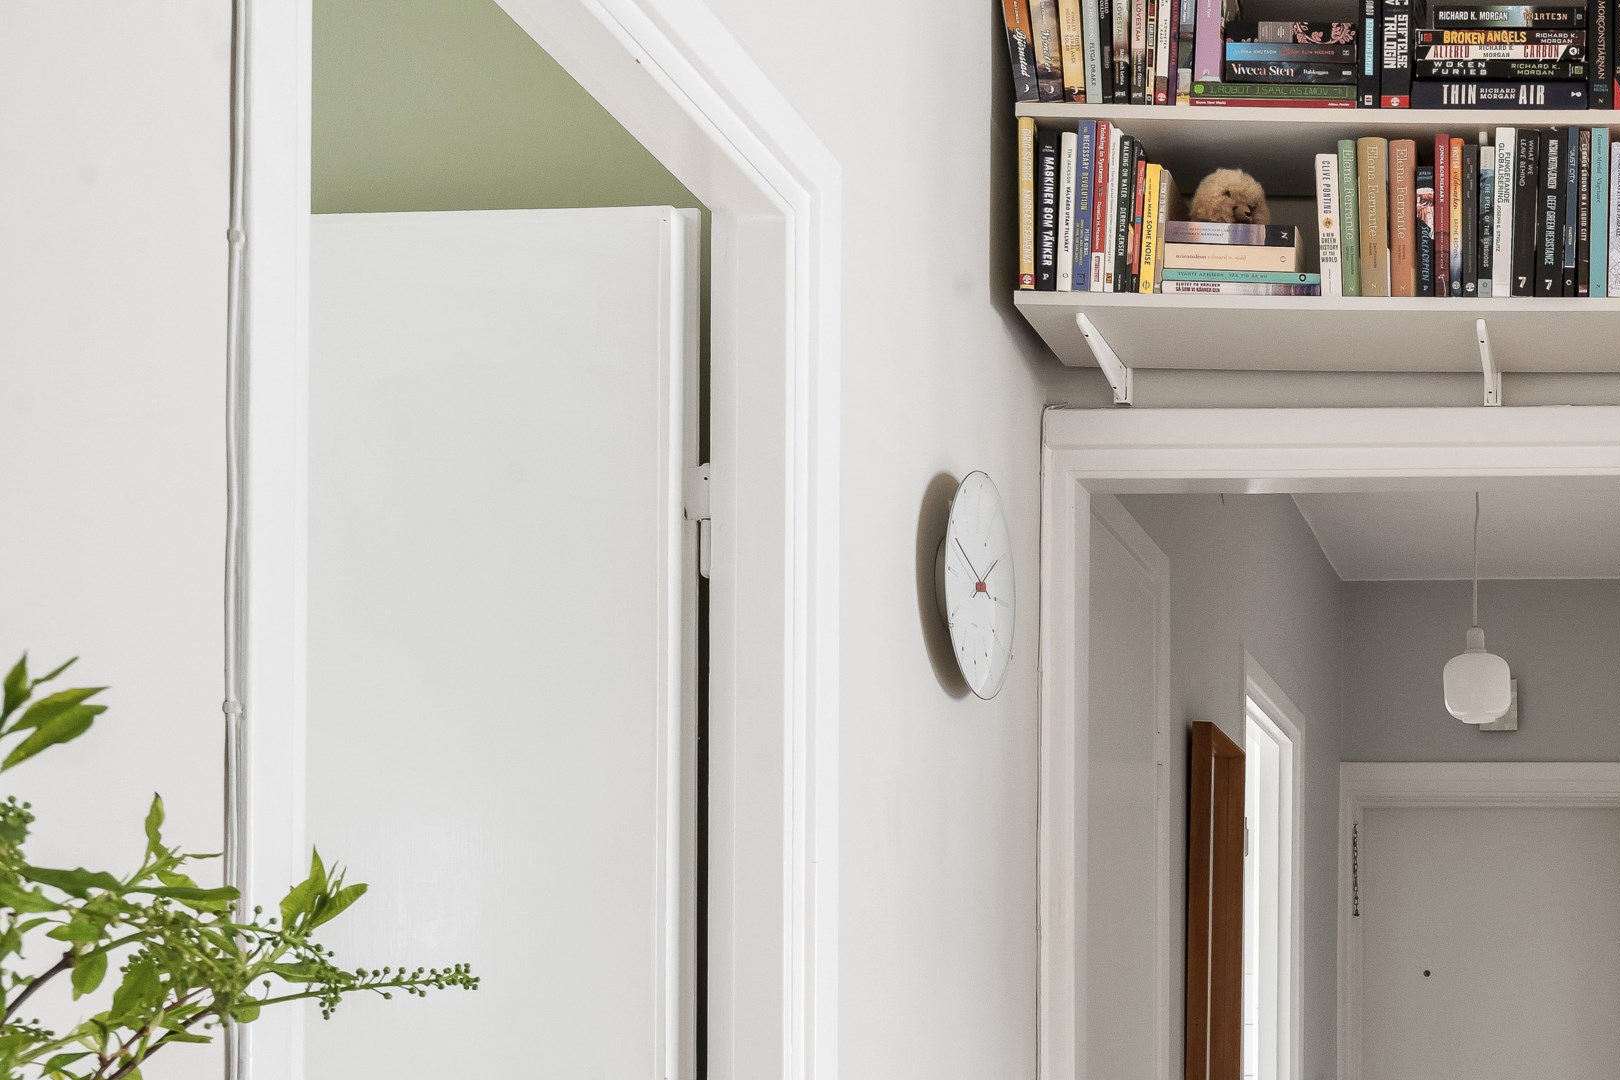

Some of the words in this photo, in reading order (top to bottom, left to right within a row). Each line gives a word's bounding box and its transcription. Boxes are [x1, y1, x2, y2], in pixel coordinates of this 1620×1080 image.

[1438, 11, 1469, 20] RICHARD
[1470, 11, 1477, 20] K.
[1479, 11, 1508, 20] MORGAN
[1384, 16, 1397, 69] TRILOGIN
[1397, 14, 1408, 69] STIFTELSE
[1443, 30, 1485, 44] BROKEN
[1487, 31, 1527, 43] ANGELS
[1013, 27, 1030, 78] Björnstad
[1433, 45, 1470, 58] ALTERED
[1523, 45, 1559, 58] CARBON
[1231, 63, 1266, 76] Viveca
[1268, 65, 1294, 77] Sten
[1256, 86, 1288, 94] ISAAC
[1290, 86, 1329, 95] ASIMOV
[1442, 84, 1477, 104] THIN
[1518, 84, 1545, 104] AIR
[1098, 123, 1108, 150] Thinking
[1082, 134, 1091, 170] NECESSARY
[1123, 140, 1131, 167] WALKING
[1366, 145, 1379, 181] Elena
[1396, 147, 1409, 183] Elena
[1097, 158, 1105, 184] Systems
[1122, 168, 1129, 177] ON
[1321, 160, 1331, 181] CLIVE
[1342, 148, 1354, 184] Elena
[1497, 142, 1505, 204] GLOBALISERING
[1503, 152, 1511, 204] FUNGERANDE
[1527, 163, 1534, 175] WE
[1568, 168, 1576, 184] CITY
[1043, 156, 1055, 205] MASKINER
[1080, 172, 1089, 211] REVOLUTION
[1121, 178, 1129, 199] WATER
[1322, 183, 1332, 214] PONTING
[1367, 183, 1379, 238] Ferrante
[1547, 195, 1557, 210] DEEP
[1043, 206, 1055, 229] SOM
[1119, 207, 1127, 233] DERRICK
[1343, 187, 1355, 241] Ferrante
[1396, 186, 1408, 240] Ferrante
[1484, 215, 1491, 223] OF
[1546, 210, 1556, 230] GREEN
[1042, 230, 1055, 267] TÄNKER
[1117, 233, 1126, 257] JENSEN
[1544, 230, 1555, 266] RESISTANCE
[1580, 228, 1588, 242] CITY
[1144, 239, 1152, 266] NOISE
